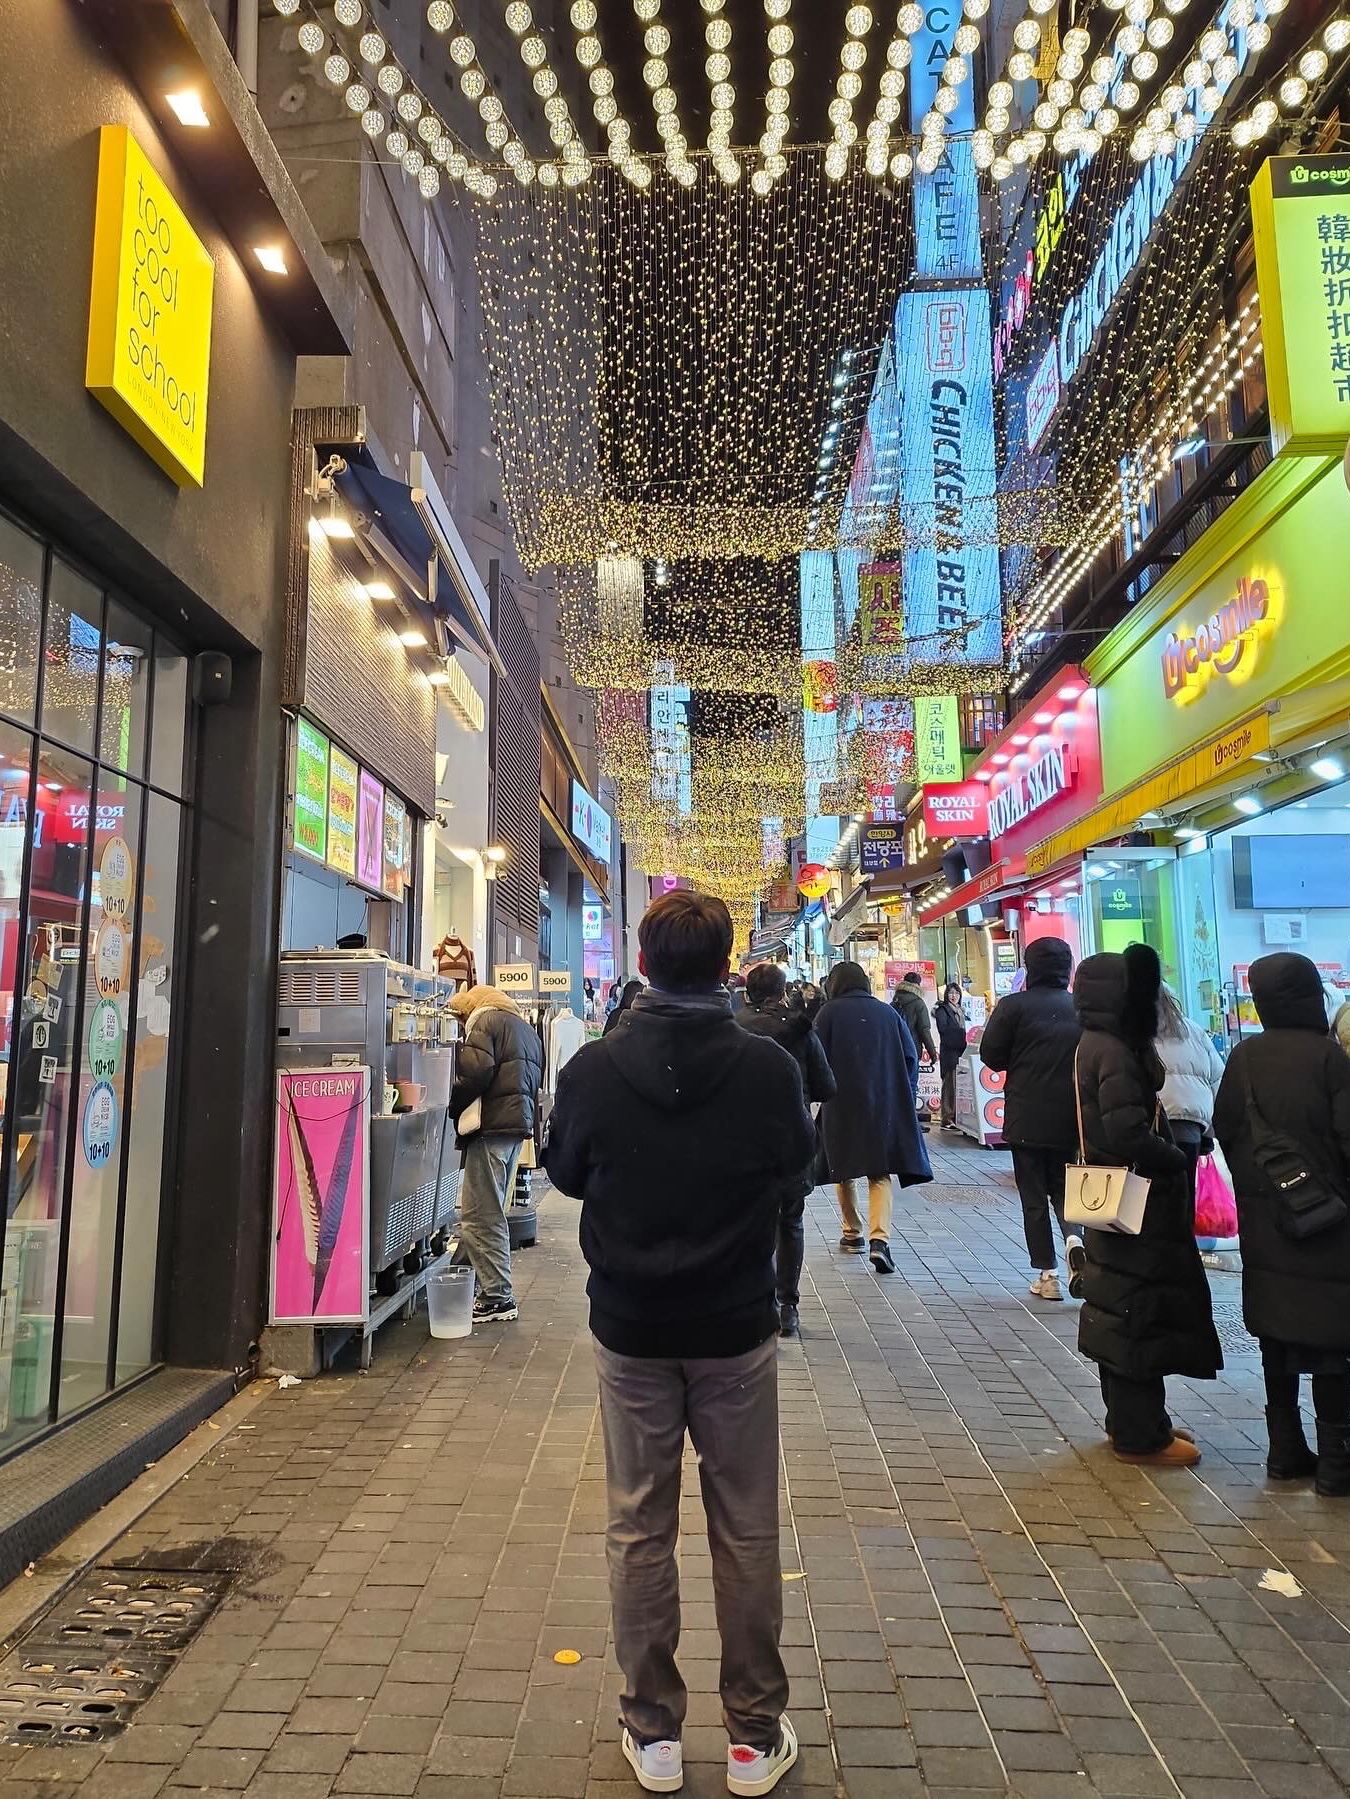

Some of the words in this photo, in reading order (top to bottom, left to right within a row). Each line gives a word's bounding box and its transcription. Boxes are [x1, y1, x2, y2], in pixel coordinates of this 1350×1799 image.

[932, 117, 957, 241] AFE
[138, 172, 170, 255] too
[134, 227, 179, 312] cool
[935, 255, 959, 271] 4F
[133, 267, 160, 337] for
[128, 327, 196, 433] school
[930, 379, 967, 529] CHICKEN
[930, 703, 945, 761] 코스메틱
[923, 763, 956, 776] 아울렛
[986, 776, 1029, 841] ROYAL
[1027, 743, 1068, 812] SKIN
[928, 796, 981, 809] ROYAL
[935, 809, 975, 822] SKIN
[862, 840, 903, 857] 전당포
[106, 895, 125, 914] 10+10
[100, 976, 120, 994] 10+10
[499, 972, 529, 982] 5900
[543, 977, 567, 985] 5900
[94, 1059, 115, 1076] 10+10
[290, 1080, 310, 1098] ICE
[312, 1078, 356, 1097] CREAM
[89, 1142, 110, 1161] 10+10
